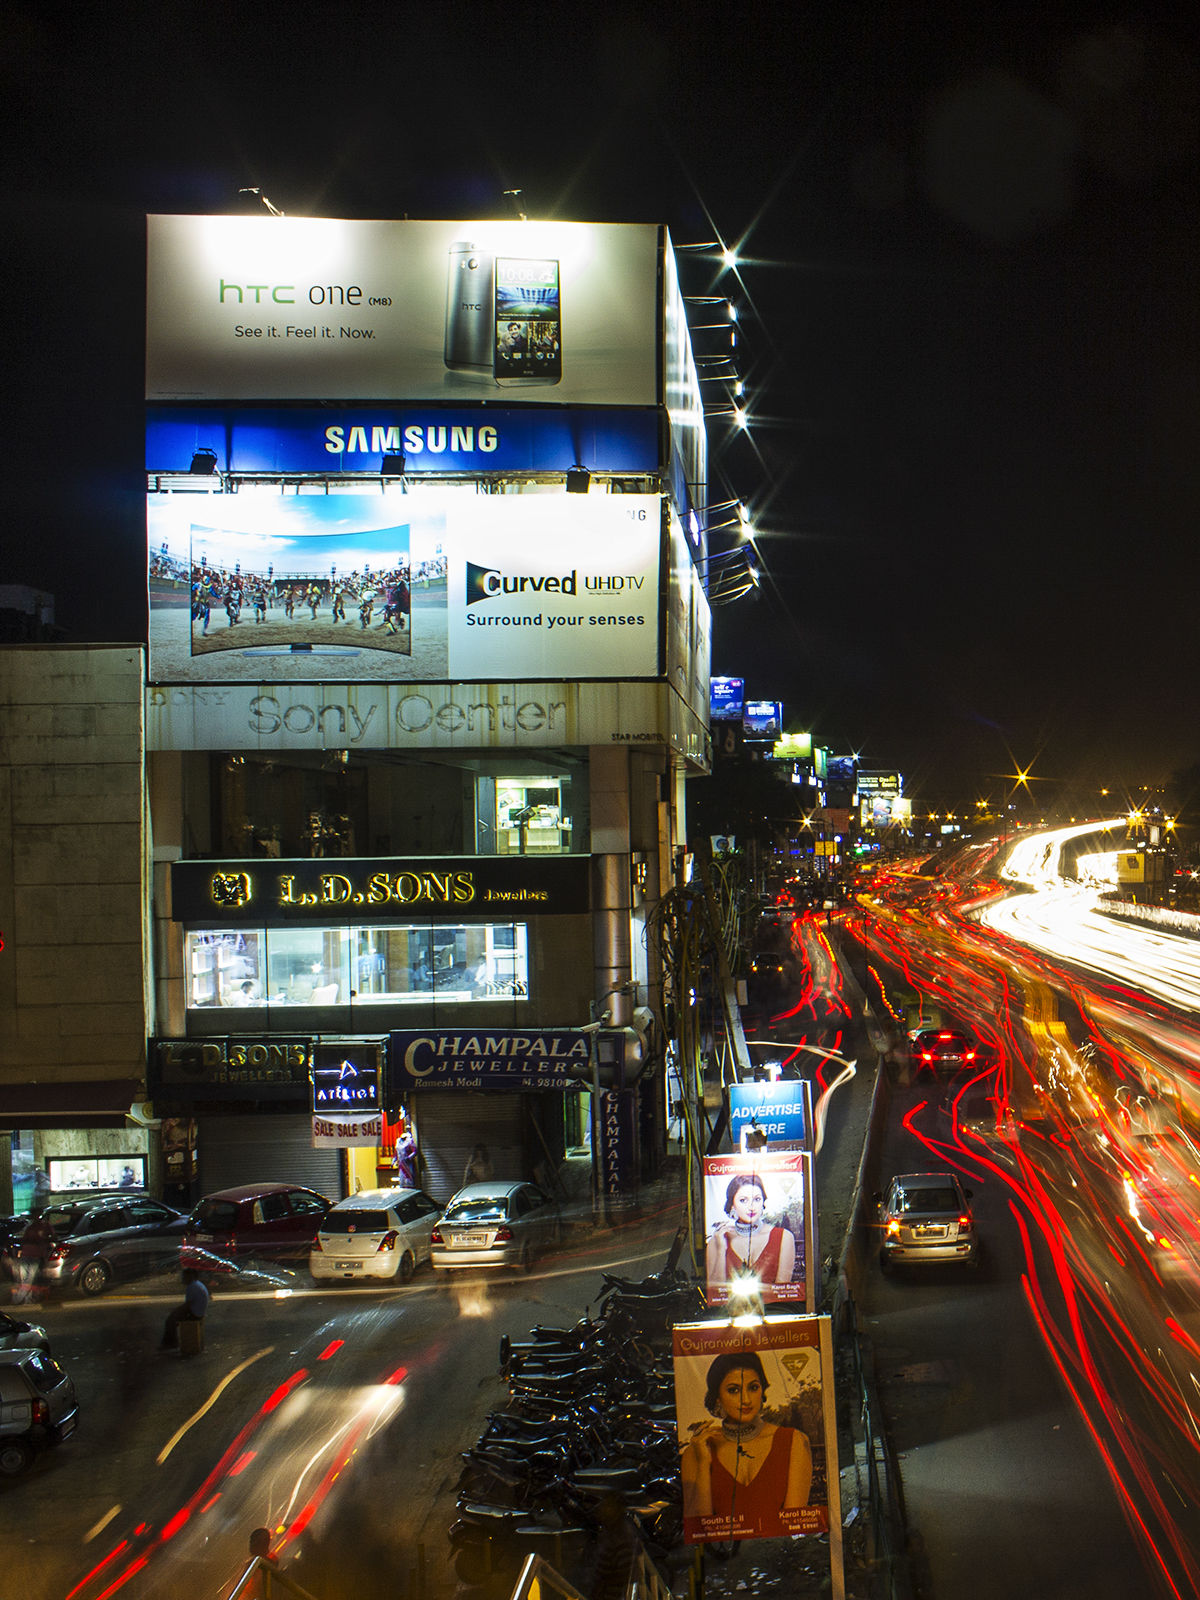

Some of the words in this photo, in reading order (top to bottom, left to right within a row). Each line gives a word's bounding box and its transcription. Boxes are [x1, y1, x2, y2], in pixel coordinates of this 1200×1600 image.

[309, 285, 363, 306] one
[368, 297, 392, 306] (M8)
[234, 325, 262, 338] See
[267, 326, 281, 338] it.
[286, 326, 316, 338] Feel
[321, 326, 335, 339] it.
[340, 327, 376, 339] Now.
[325, 425, 498, 453] SAMSUNG
[483, 569, 577, 597] Curved
[467, 613, 543, 626] Surround
[547, 615, 584, 629] your
[589, 615, 645, 626] senses
[248, 695, 378, 742] Sony
[396, 694, 566, 733] Center
[404, 1036, 589, 1077] CHAMPALA
[415, 1077, 454, 1088] Ramesh
[456, 1077, 482, 1088] Modi
[731, 1103, 802, 1119] ADVERTISE
[314, 1121, 334, 1136] SALE
[337, 1123, 358, 1137] SALE
[362, 1121, 382, 1136] SALE
[680, 1335, 752, 1352] Gujranwala
[755, 1329, 810, 1346] Jewellers
[701, 1516, 724, 1525] South
[779, 1510, 800, 1519] Karol
[801, 1508, 821, 1518] Bagh
